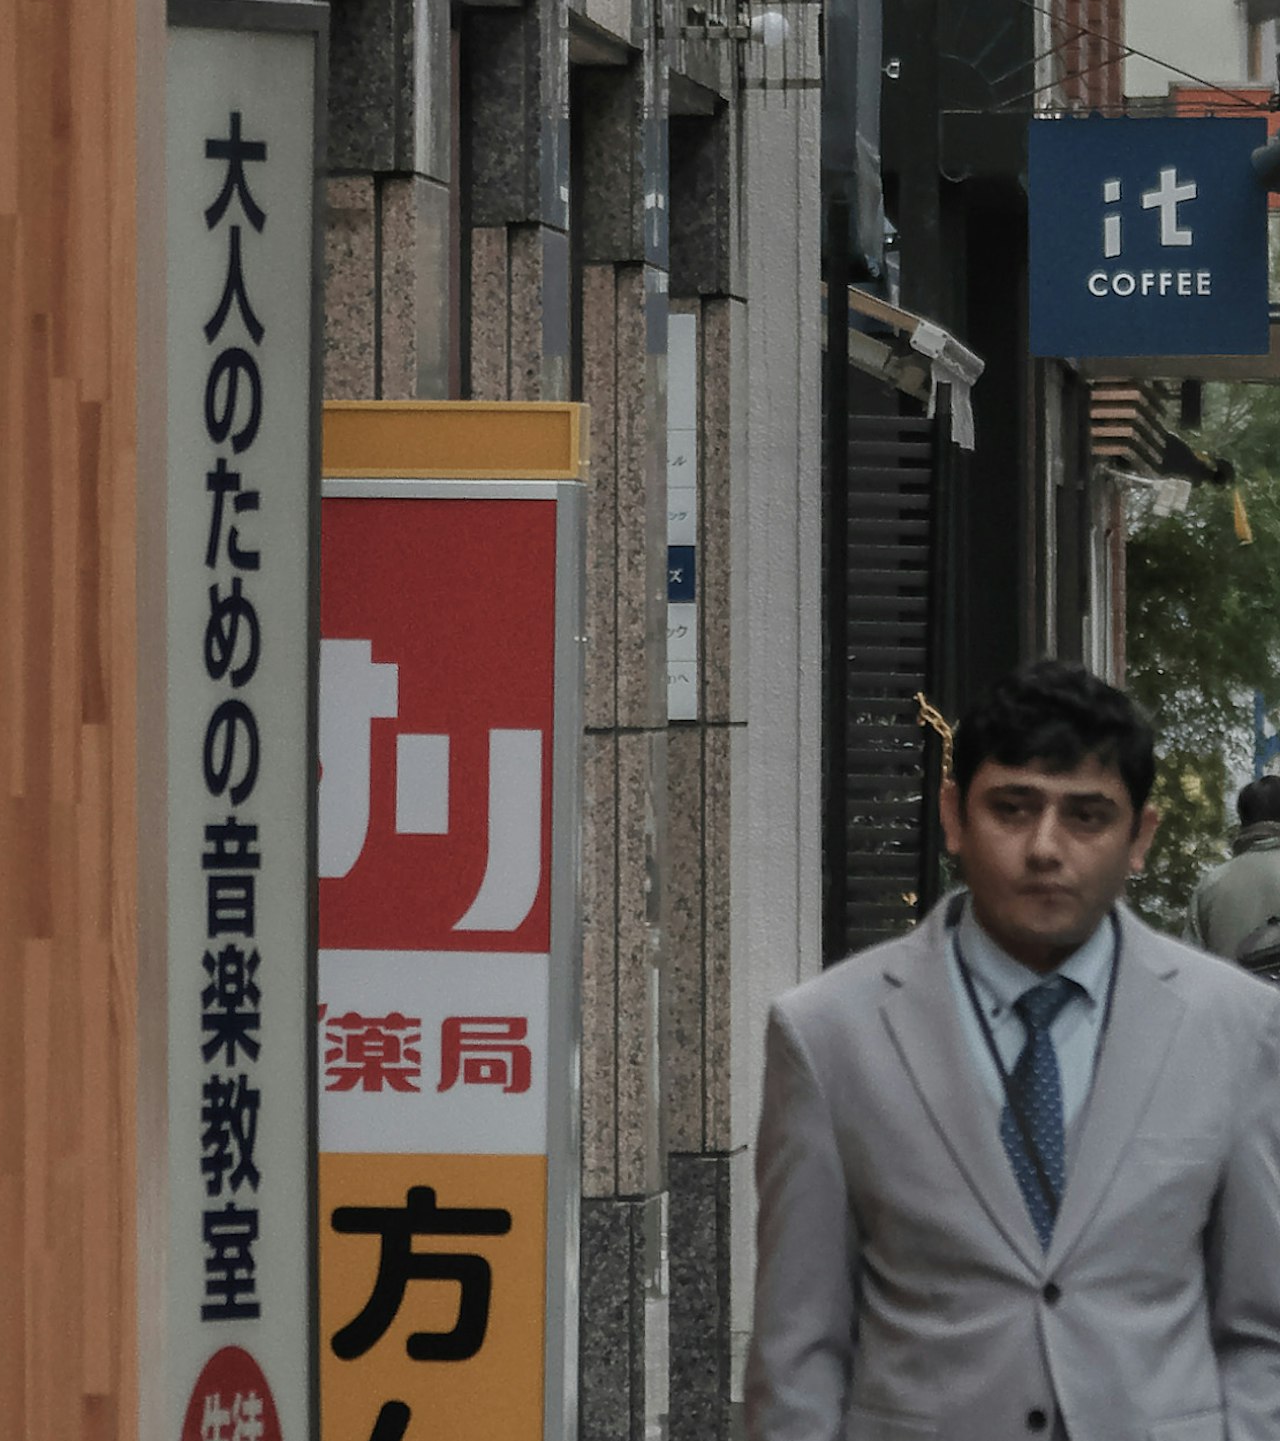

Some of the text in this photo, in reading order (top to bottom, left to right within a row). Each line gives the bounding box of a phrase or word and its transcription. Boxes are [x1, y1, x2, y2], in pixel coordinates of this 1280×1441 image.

[1103, 167, 1198, 259] it
[1087, 271, 1213, 298] COFFEE
[201, 110, 269, 1324] 大人のための音楽教室
[324, 1010, 533, 1097] 薬局
[329, 1184, 514, 1364] 方
